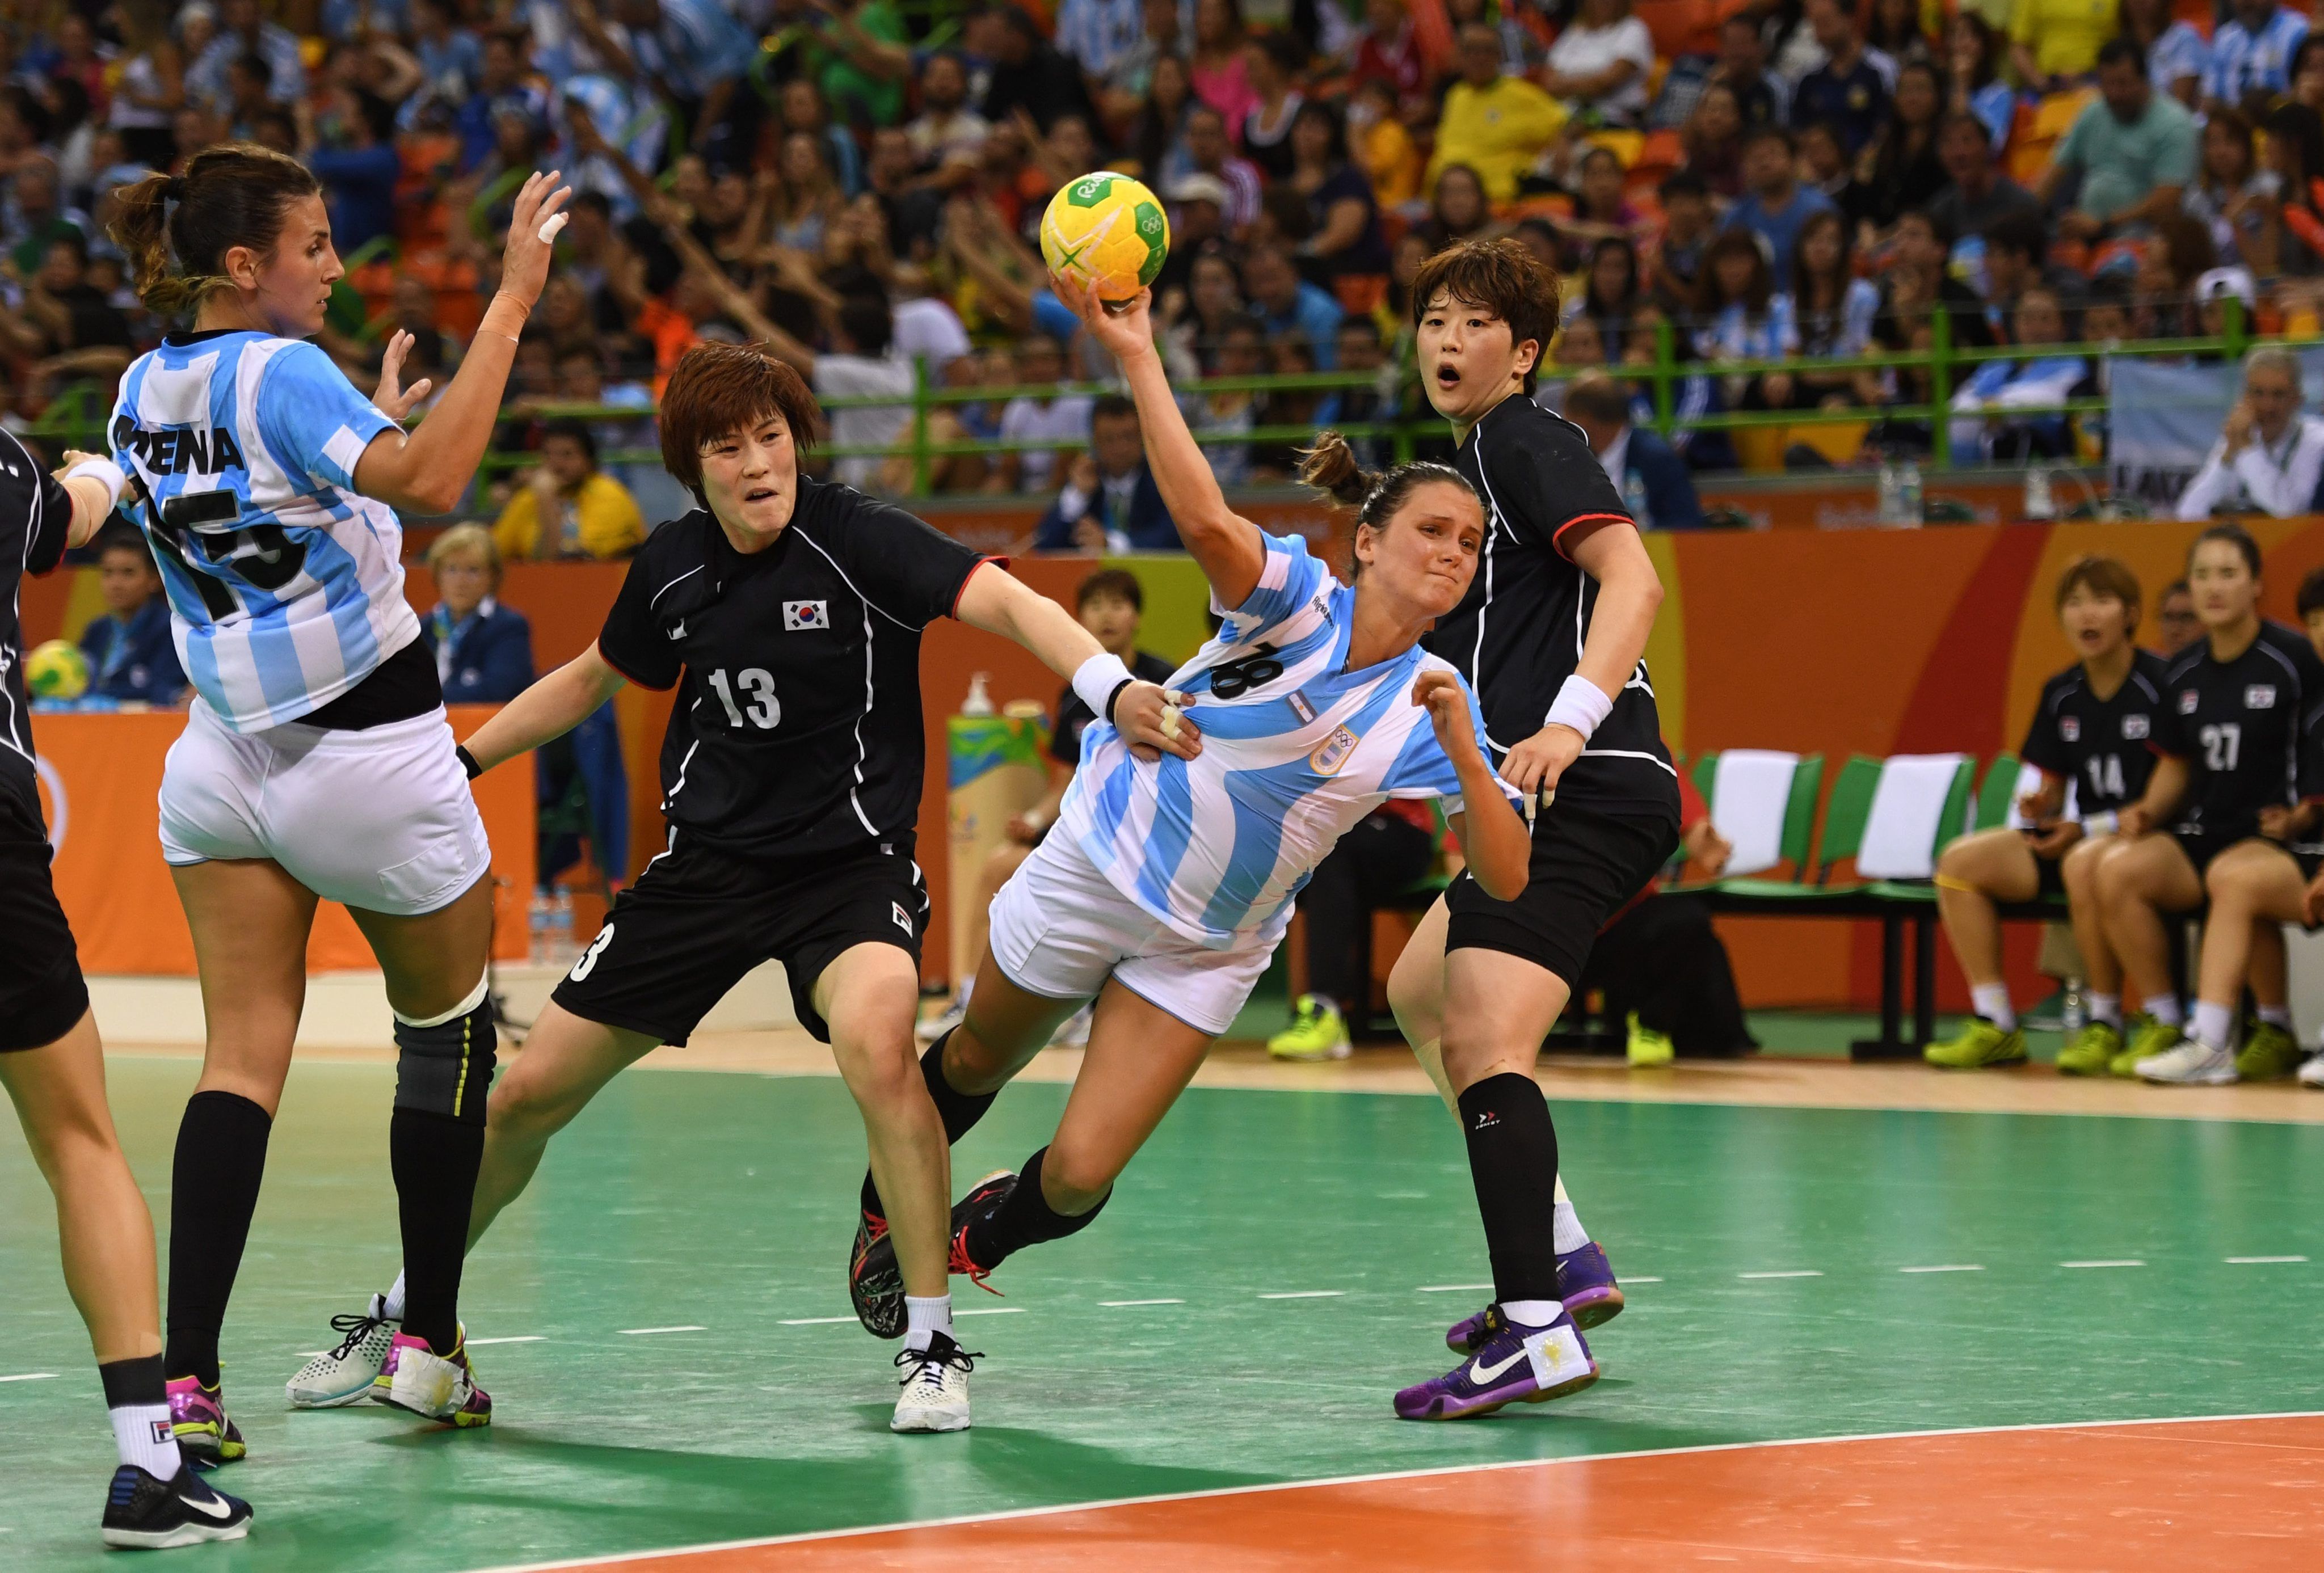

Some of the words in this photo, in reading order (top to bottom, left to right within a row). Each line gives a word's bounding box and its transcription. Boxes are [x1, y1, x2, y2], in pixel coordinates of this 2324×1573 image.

[128, 474, 307, 623] 15
[708, 668, 781, 729] 13
[1209, 641, 1283, 699] 18
[2085, 752, 2126, 799] 14
[2200, 722, 2242, 771] 27
